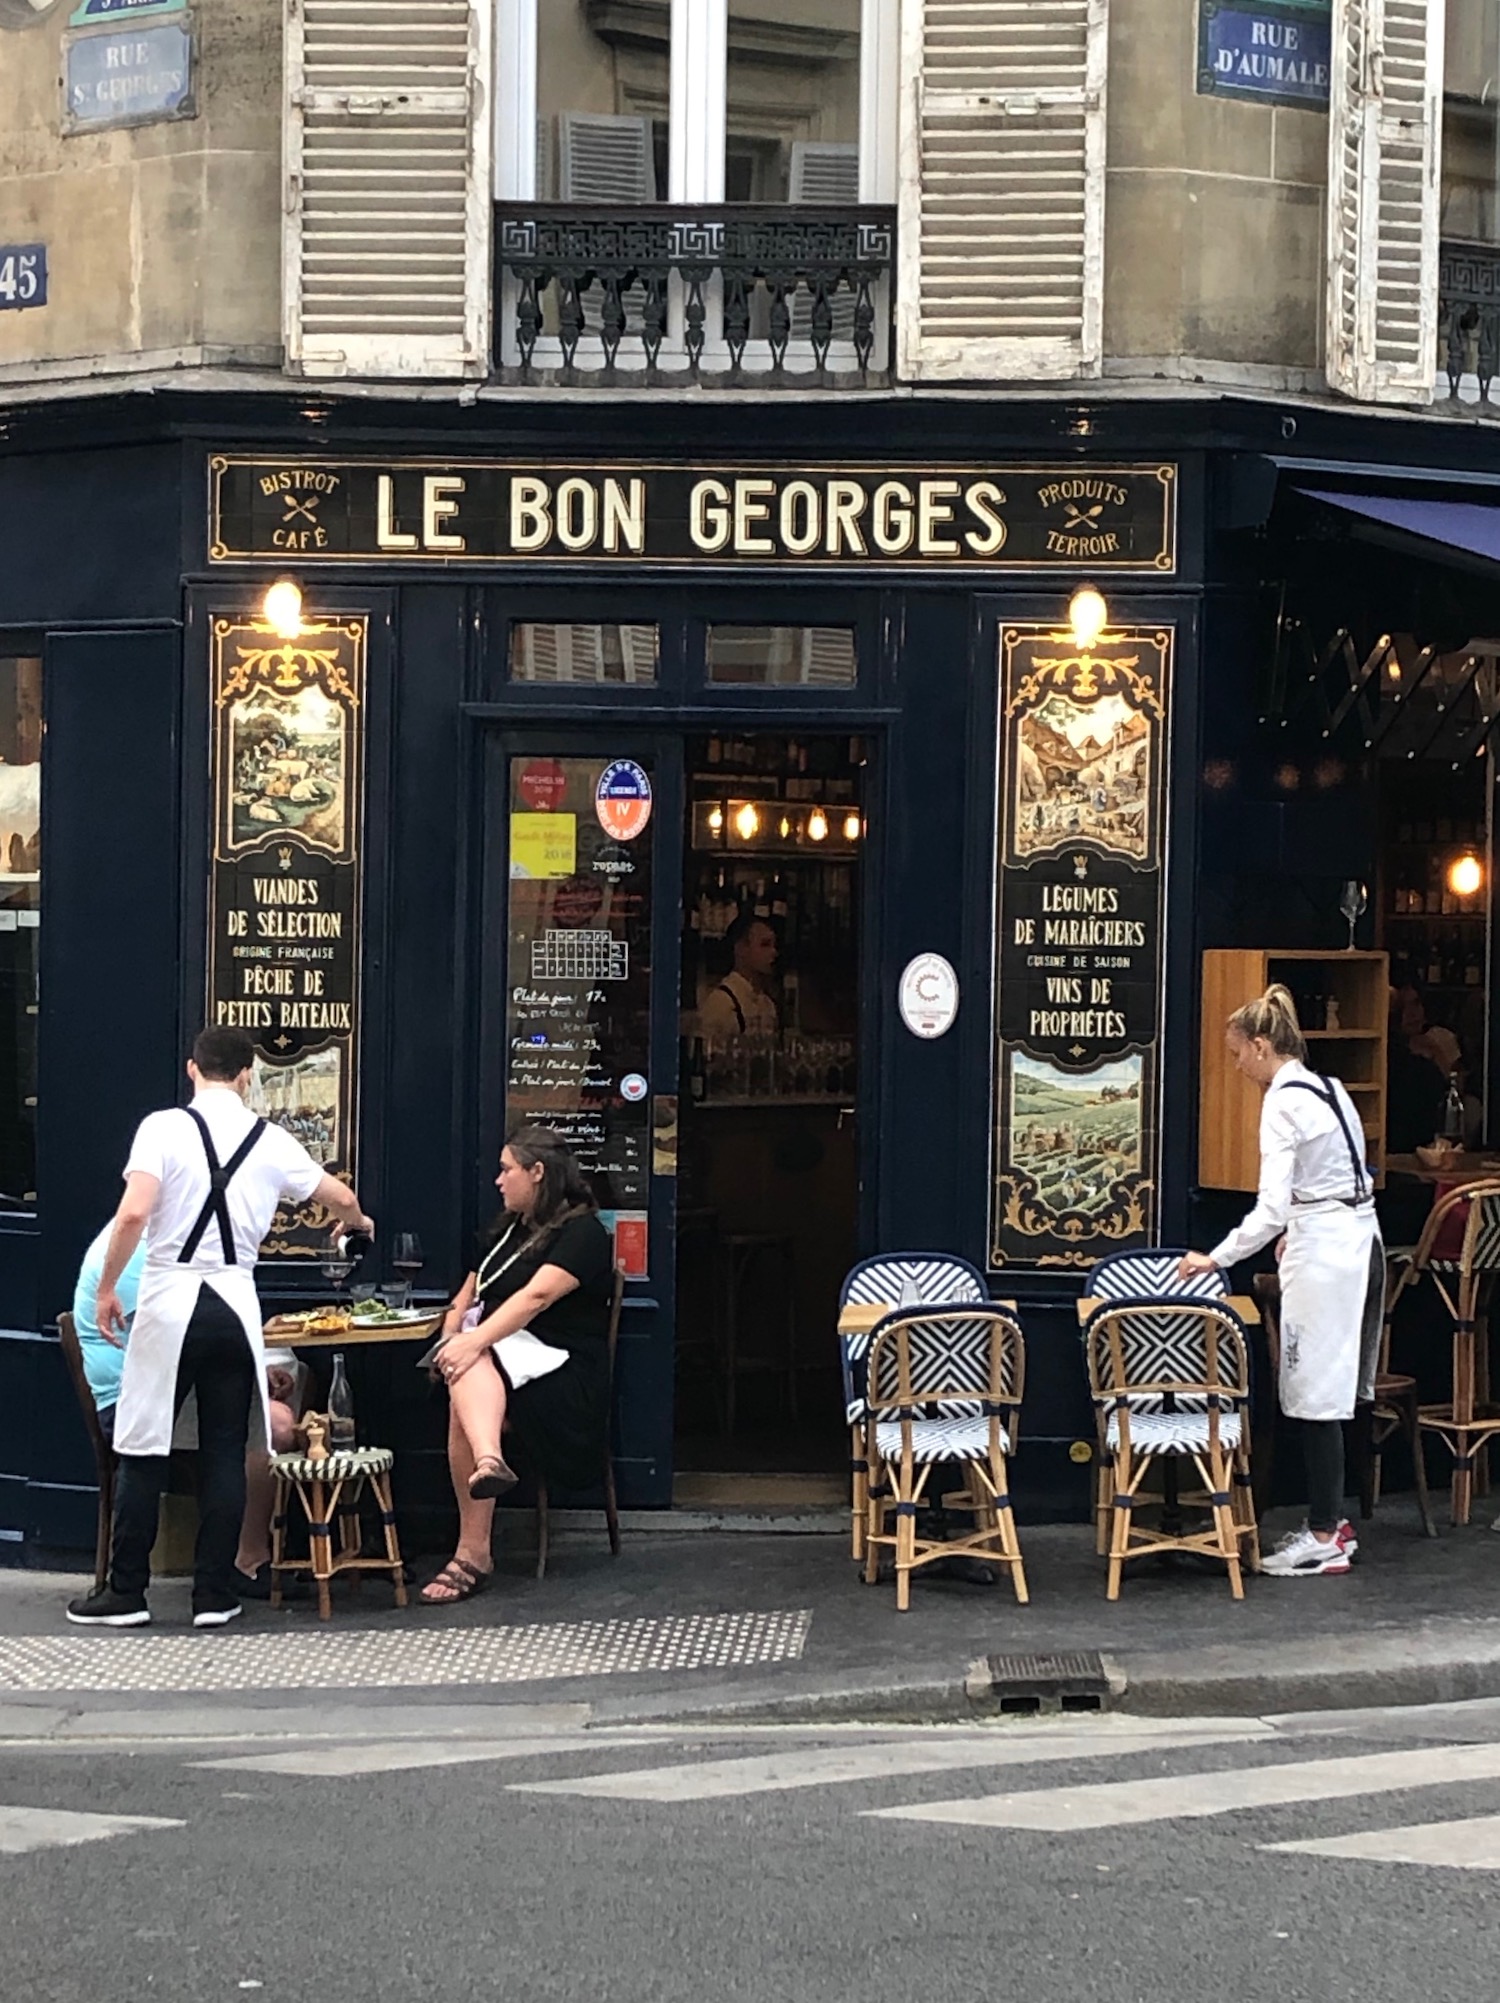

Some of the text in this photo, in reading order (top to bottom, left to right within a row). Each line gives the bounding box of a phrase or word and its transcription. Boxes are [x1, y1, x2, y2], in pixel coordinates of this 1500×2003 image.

[1251, 21, 1298, 50] RUE
[106, 42, 149, 69] RUE
[1216, 48, 1328, 86] D'AUMALE
[0, 255, 37, 300] 45
[259, 470, 340, 496] BISTROT
[1037, 480, 1129, 508] PRODUITS
[378, 475, 1007, 556] LE BON GEORGES
[1046, 530, 1120, 556] TERROIR
[615, 801, 631, 817] IV
[253, 878, 318, 905] VIANDES
[1042, 884, 1118, 913] LÉGUMES
[227, 909, 342, 938] DE SÉLECTION
[1014, 915, 1145, 946] DE MARAÎCHERS
[232, 946, 334, 961] ORIGINE FRANÇAISE
[1027, 955, 1131, 968] CUISINE DE SAISON
[243, 964, 324, 996] PÊCHE DE
[1046, 977, 1112, 1005] VINS DE
[217, 1001, 350, 1028] PETITS BATEAUX
[1030, 1009, 1126, 1038] PROPRIÉTÉS
